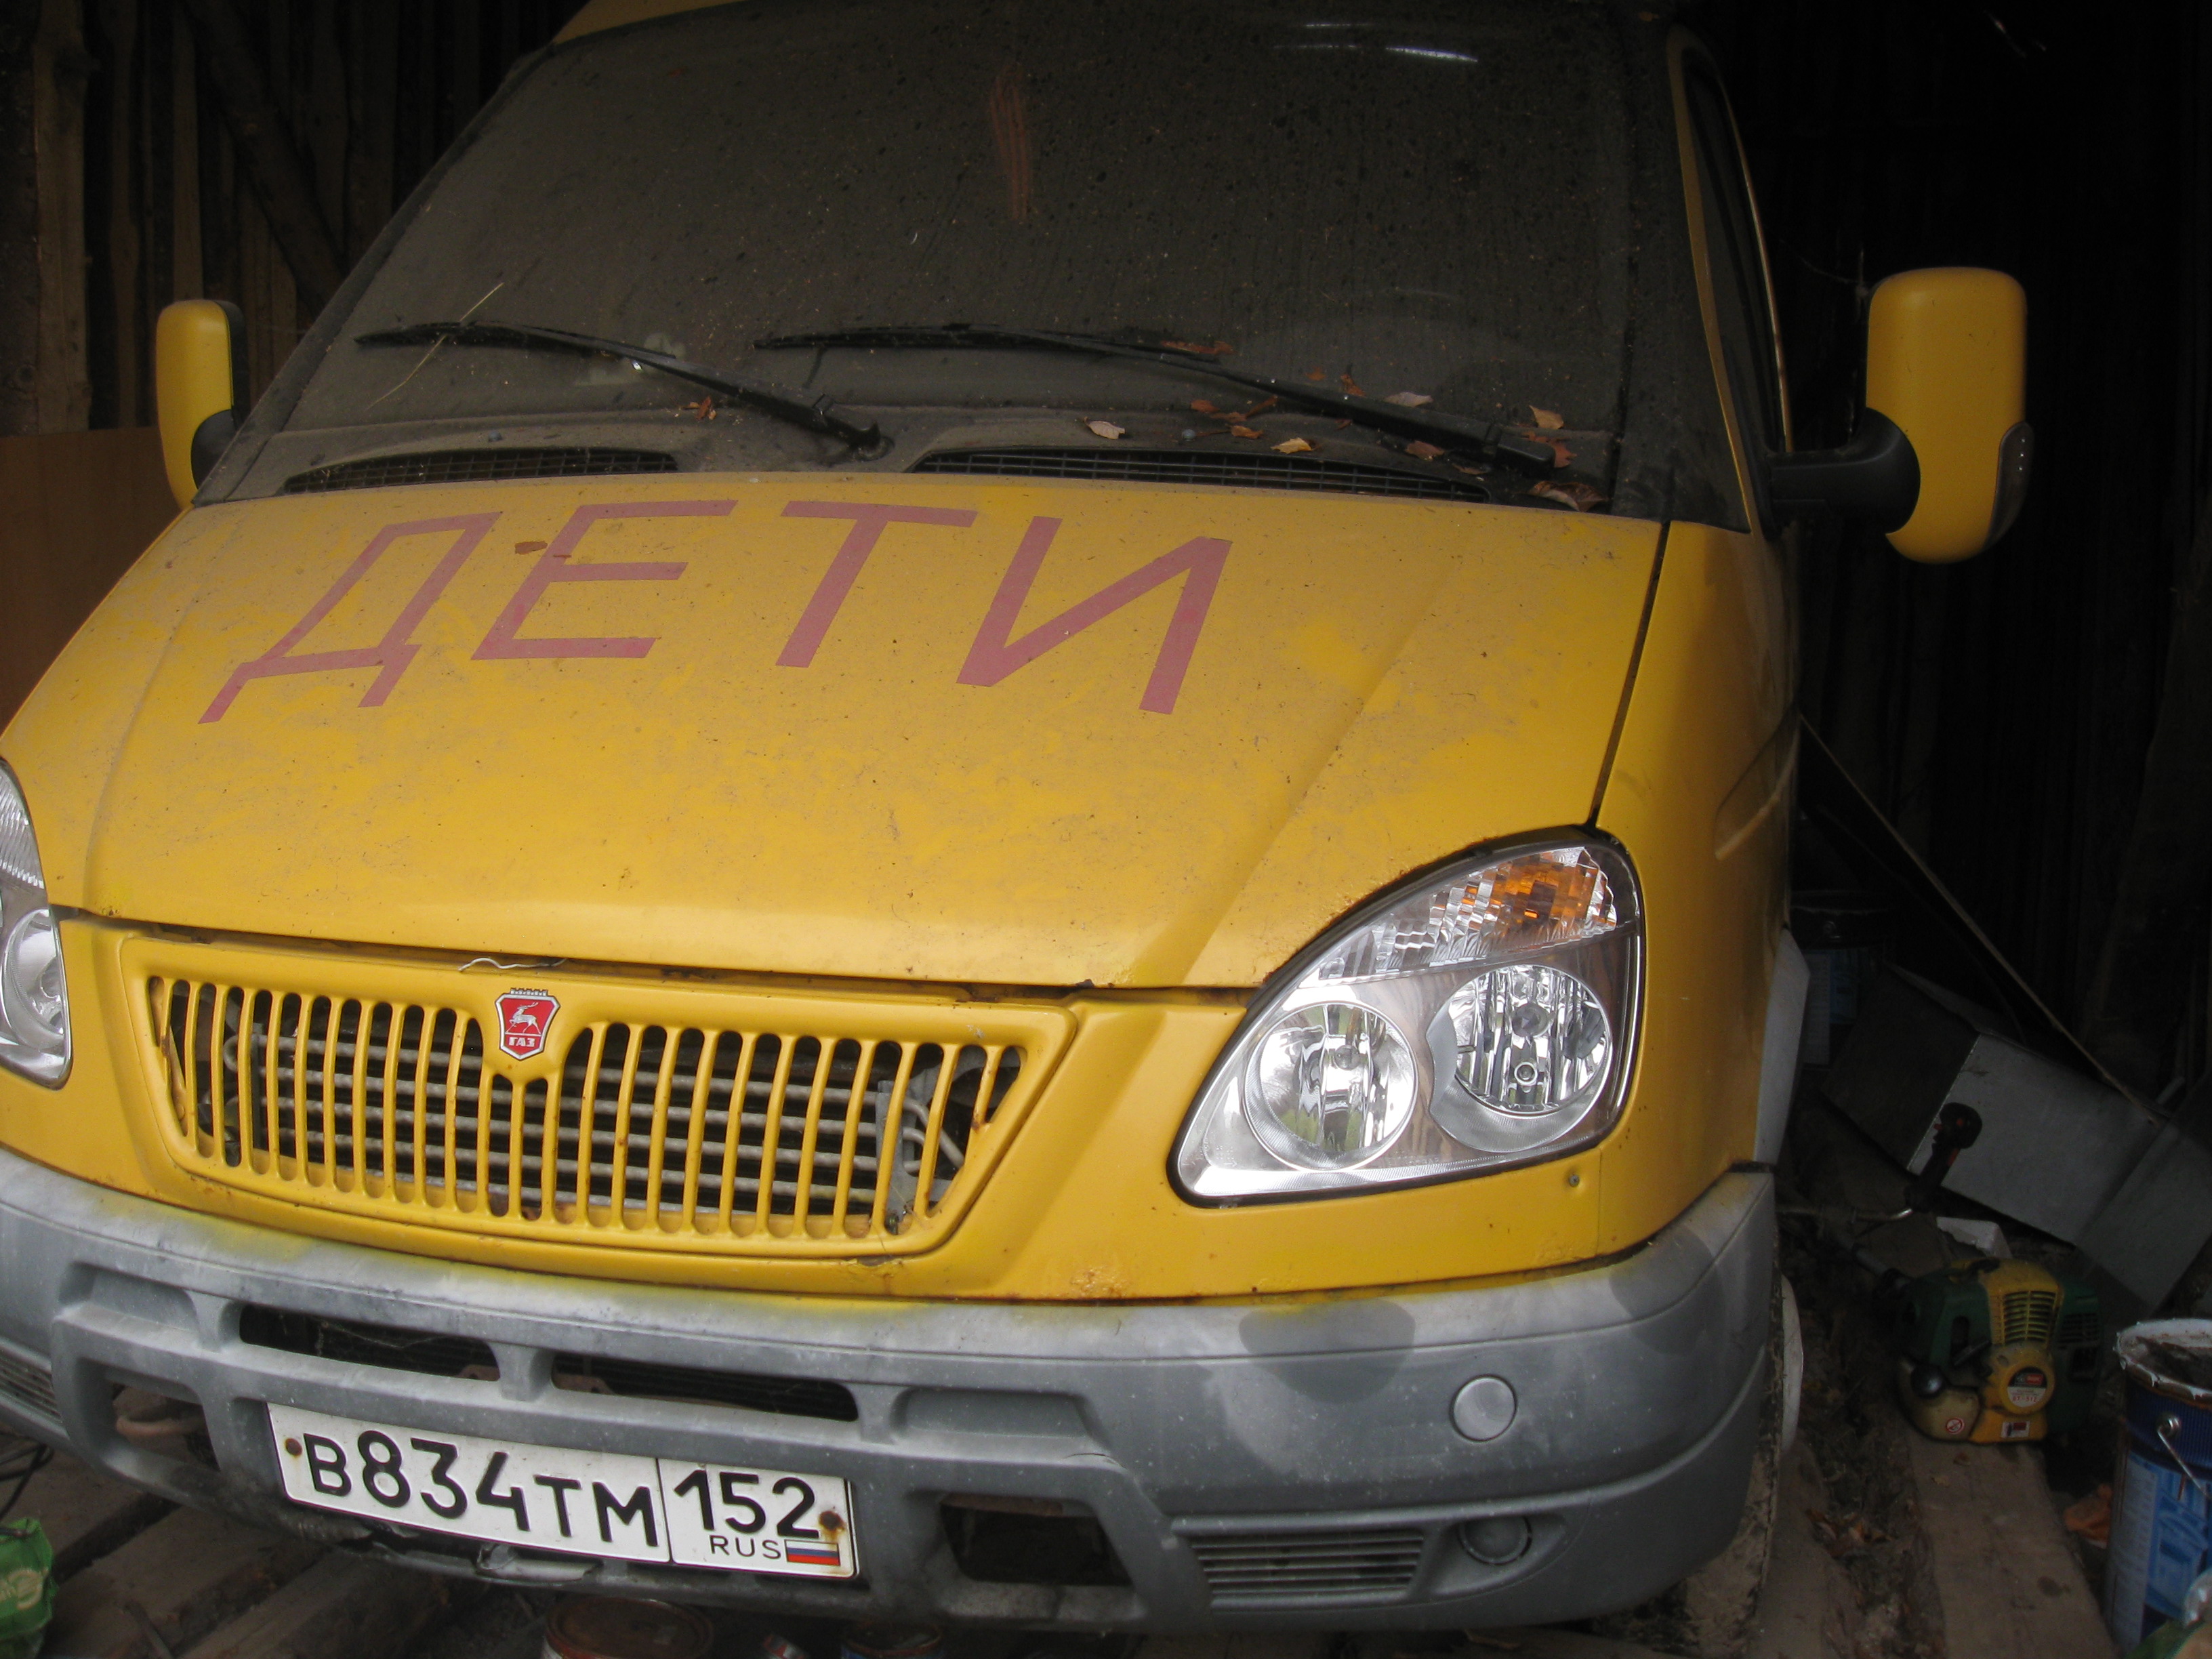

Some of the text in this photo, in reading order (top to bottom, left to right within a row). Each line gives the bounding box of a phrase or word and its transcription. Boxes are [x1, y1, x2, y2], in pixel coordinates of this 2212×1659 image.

[198, 499, 1233, 725] ДЕТИ
[508, 1036, 535, 1048] ГАЗ
[674, 1469, 820, 1539] 152
[710, 1536, 782, 1560] RUS
